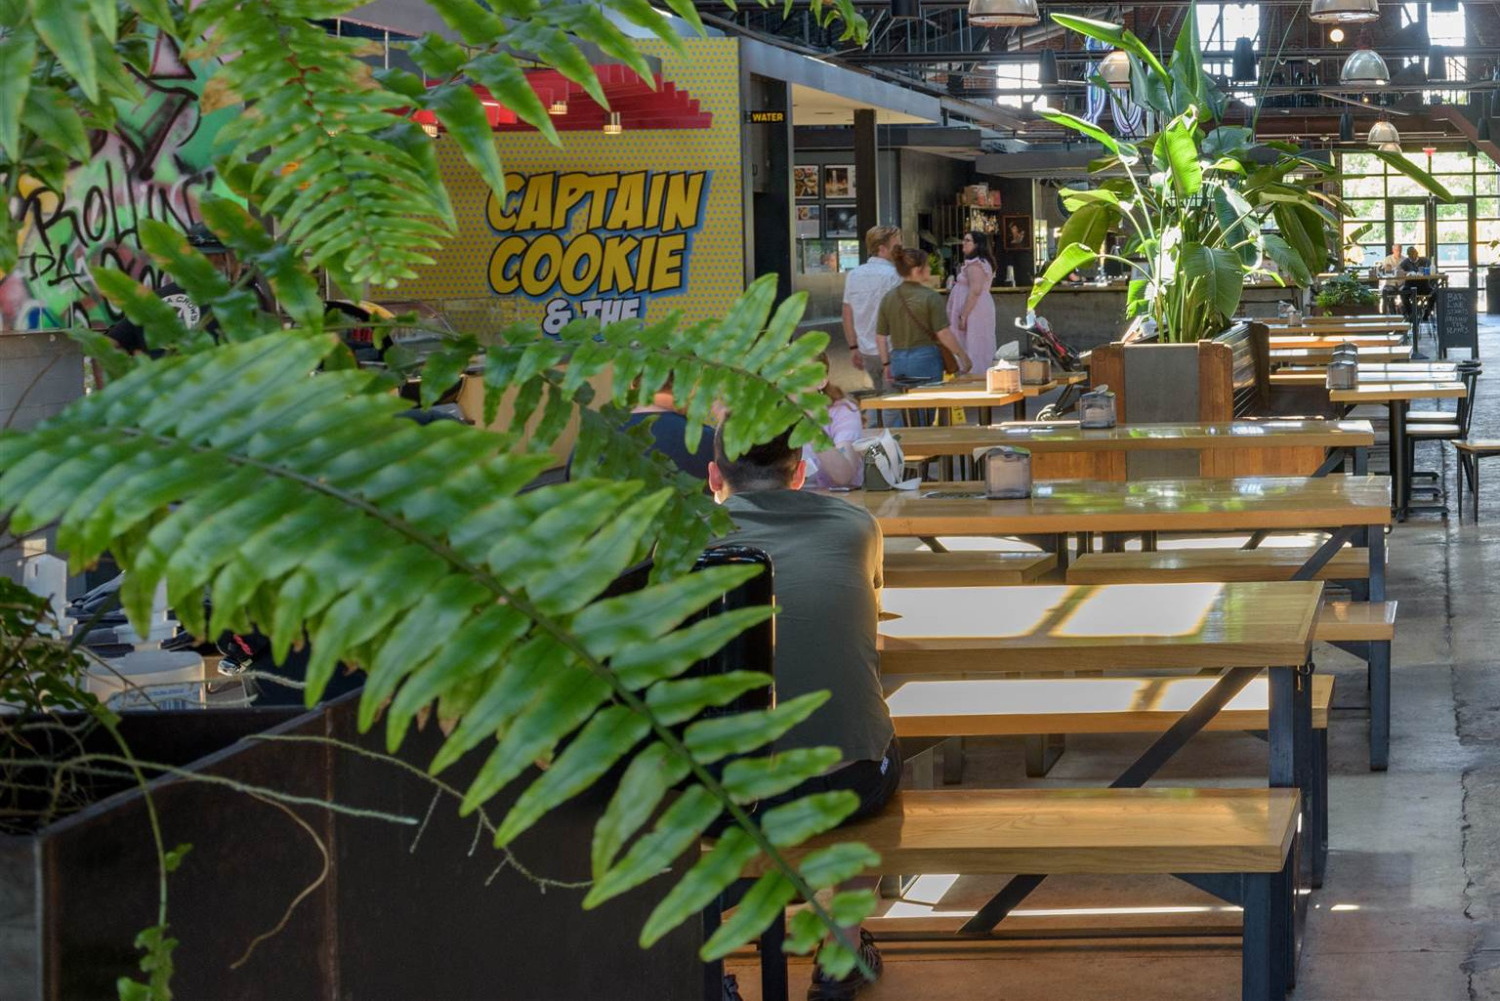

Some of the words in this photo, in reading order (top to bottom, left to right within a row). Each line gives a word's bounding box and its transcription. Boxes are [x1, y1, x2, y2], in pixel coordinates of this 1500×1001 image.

[752, 112, 784, 122] WATER
[485, 169, 707, 233] CAPTAIN
[487, 232, 688, 296] COOKIE
[541, 298, 573, 335] &
